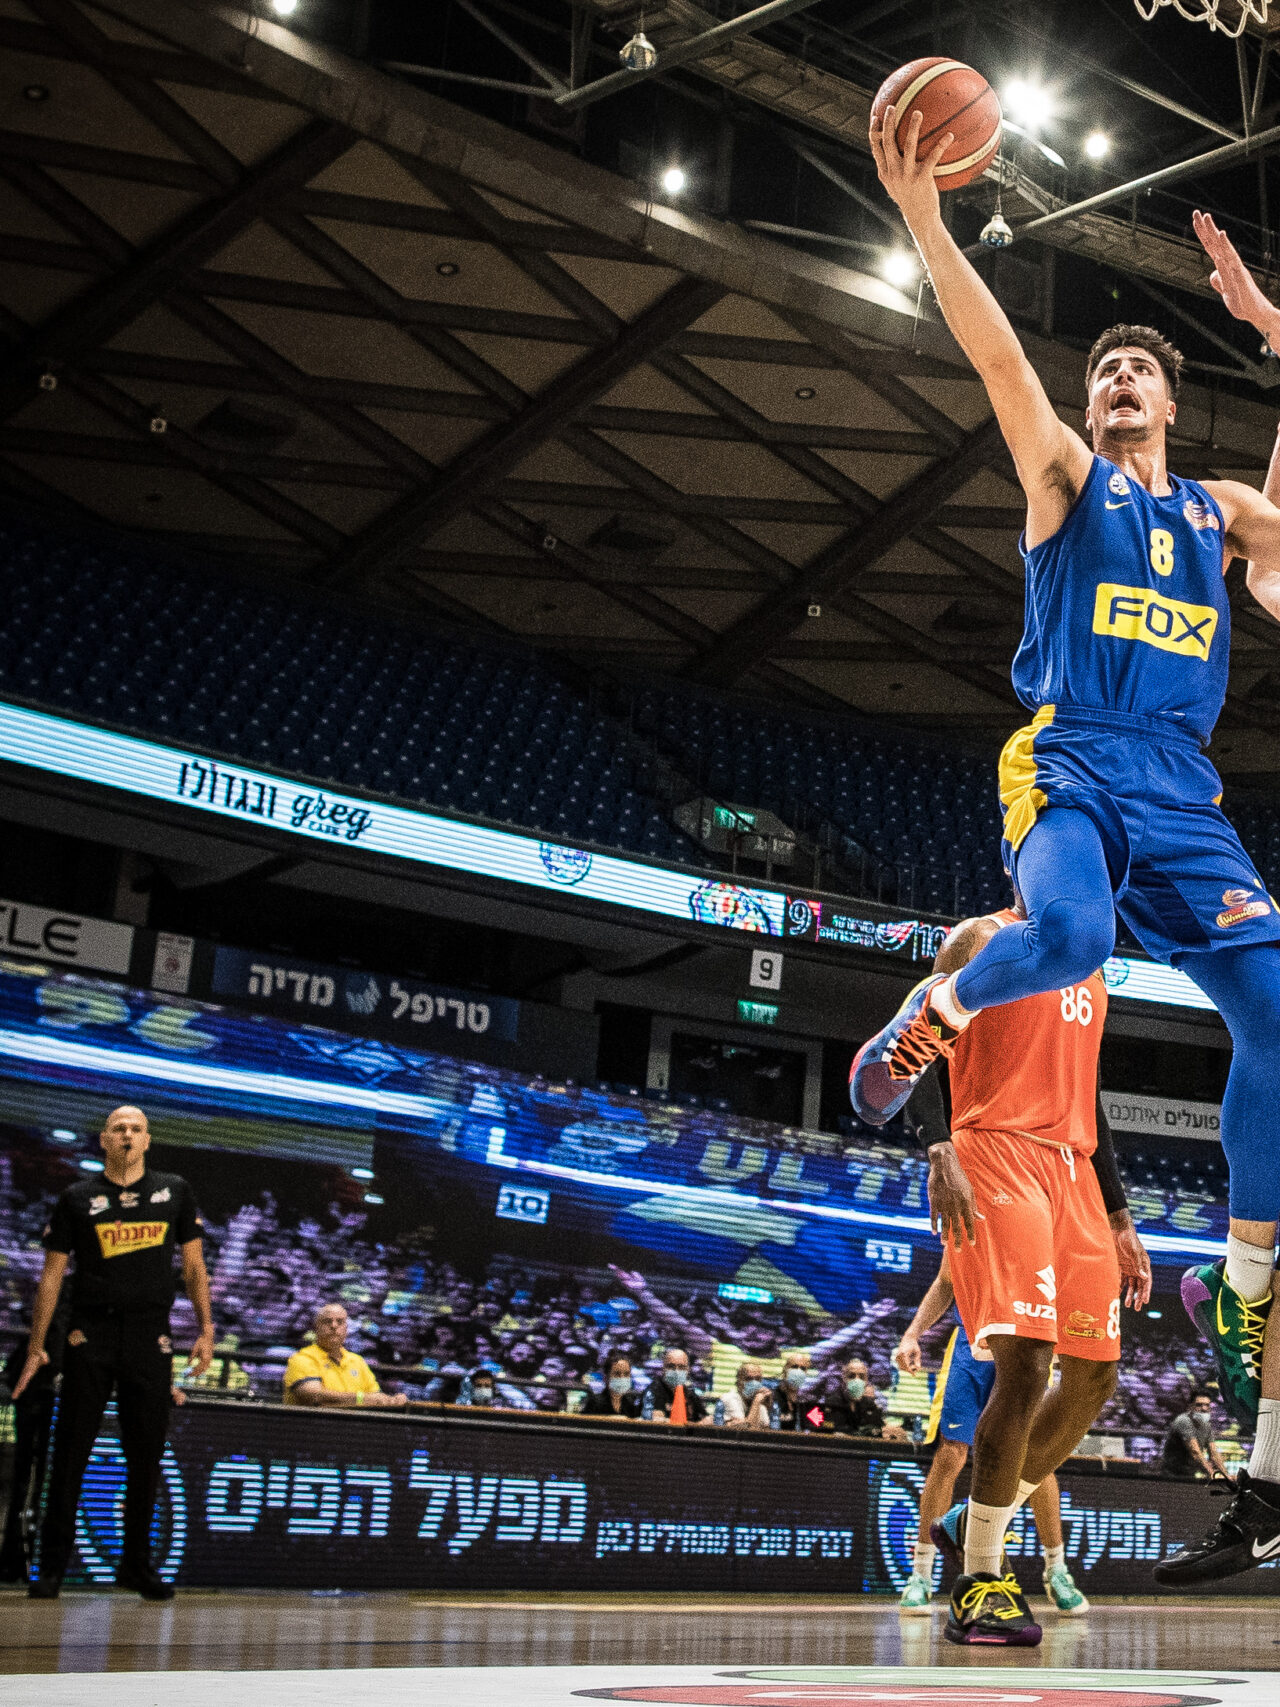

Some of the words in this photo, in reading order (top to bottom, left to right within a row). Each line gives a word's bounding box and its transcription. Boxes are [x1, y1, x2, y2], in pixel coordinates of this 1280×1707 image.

[1149, 528, 1174, 577] 8
[1109, 596, 1212, 648] FOX
[291, 792, 372, 841] greg
[0, 902, 81, 957] LE
[248, 962, 336, 1008] מדיה
[758, 958, 774, 981] 9
[388, 981, 491, 1034] טריפל
[1060, 986, 1094, 1027] 86
[1109, 1103, 1162, 1125] איתכם
[1164, 1108, 1221, 1131] פועלים
[206, 1455, 392, 1538] הפיס
[409, 1450, 588, 1556] מפעל
[1059, 1491, 1162, 1571] מפעל
